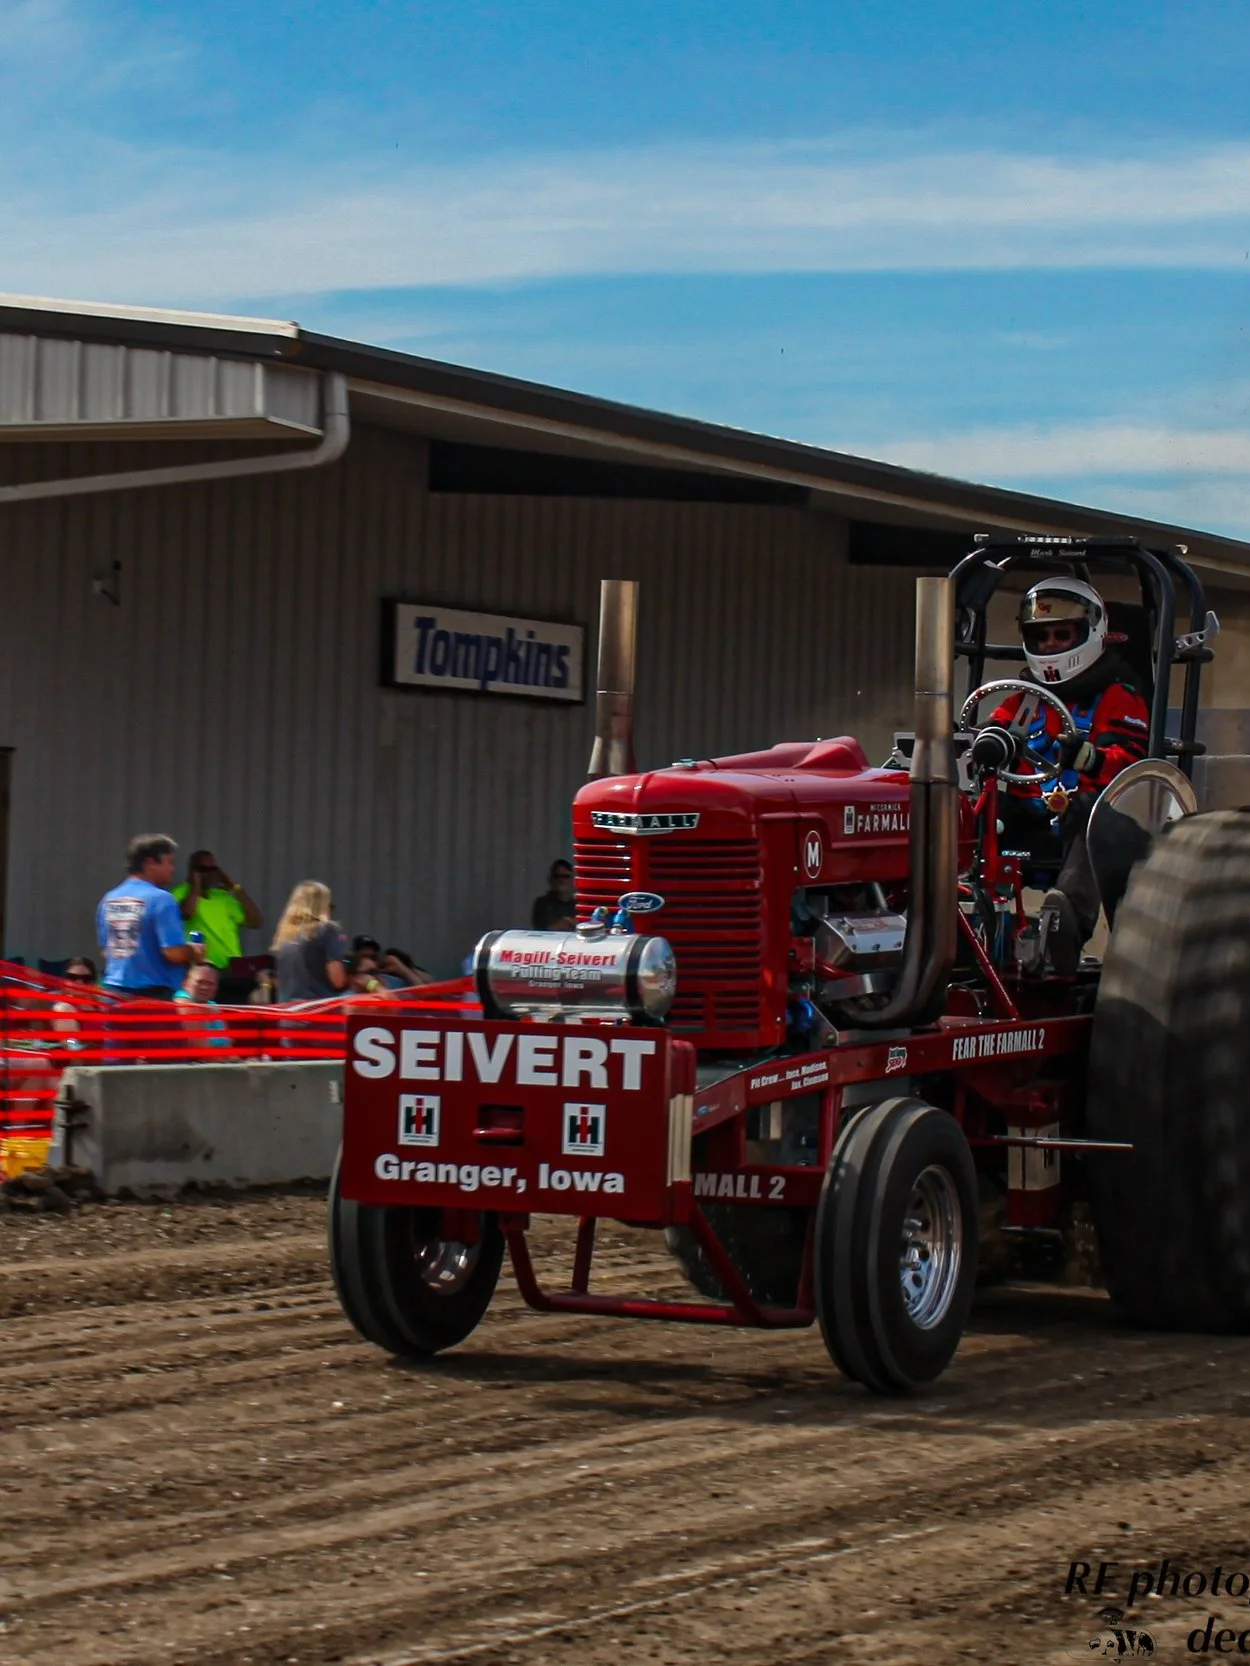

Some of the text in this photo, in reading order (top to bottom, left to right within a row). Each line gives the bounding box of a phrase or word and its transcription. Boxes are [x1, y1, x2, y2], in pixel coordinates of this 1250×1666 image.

[414, 616, 570, 691] Tompkins
[807, 842, 820, 868] M
[500, 950, 617, 967] Magill-Seivert
[511, 965, 602, 981] Pulling Team
[352, 1027, 656, 1090] SEIVERT
[952, 1028, 1045, 1061] FEAR THE FARMALL 2
[374, 1153, 625, 1193] Granger, Iowa
[768, 1176, 786, 1199] 2
